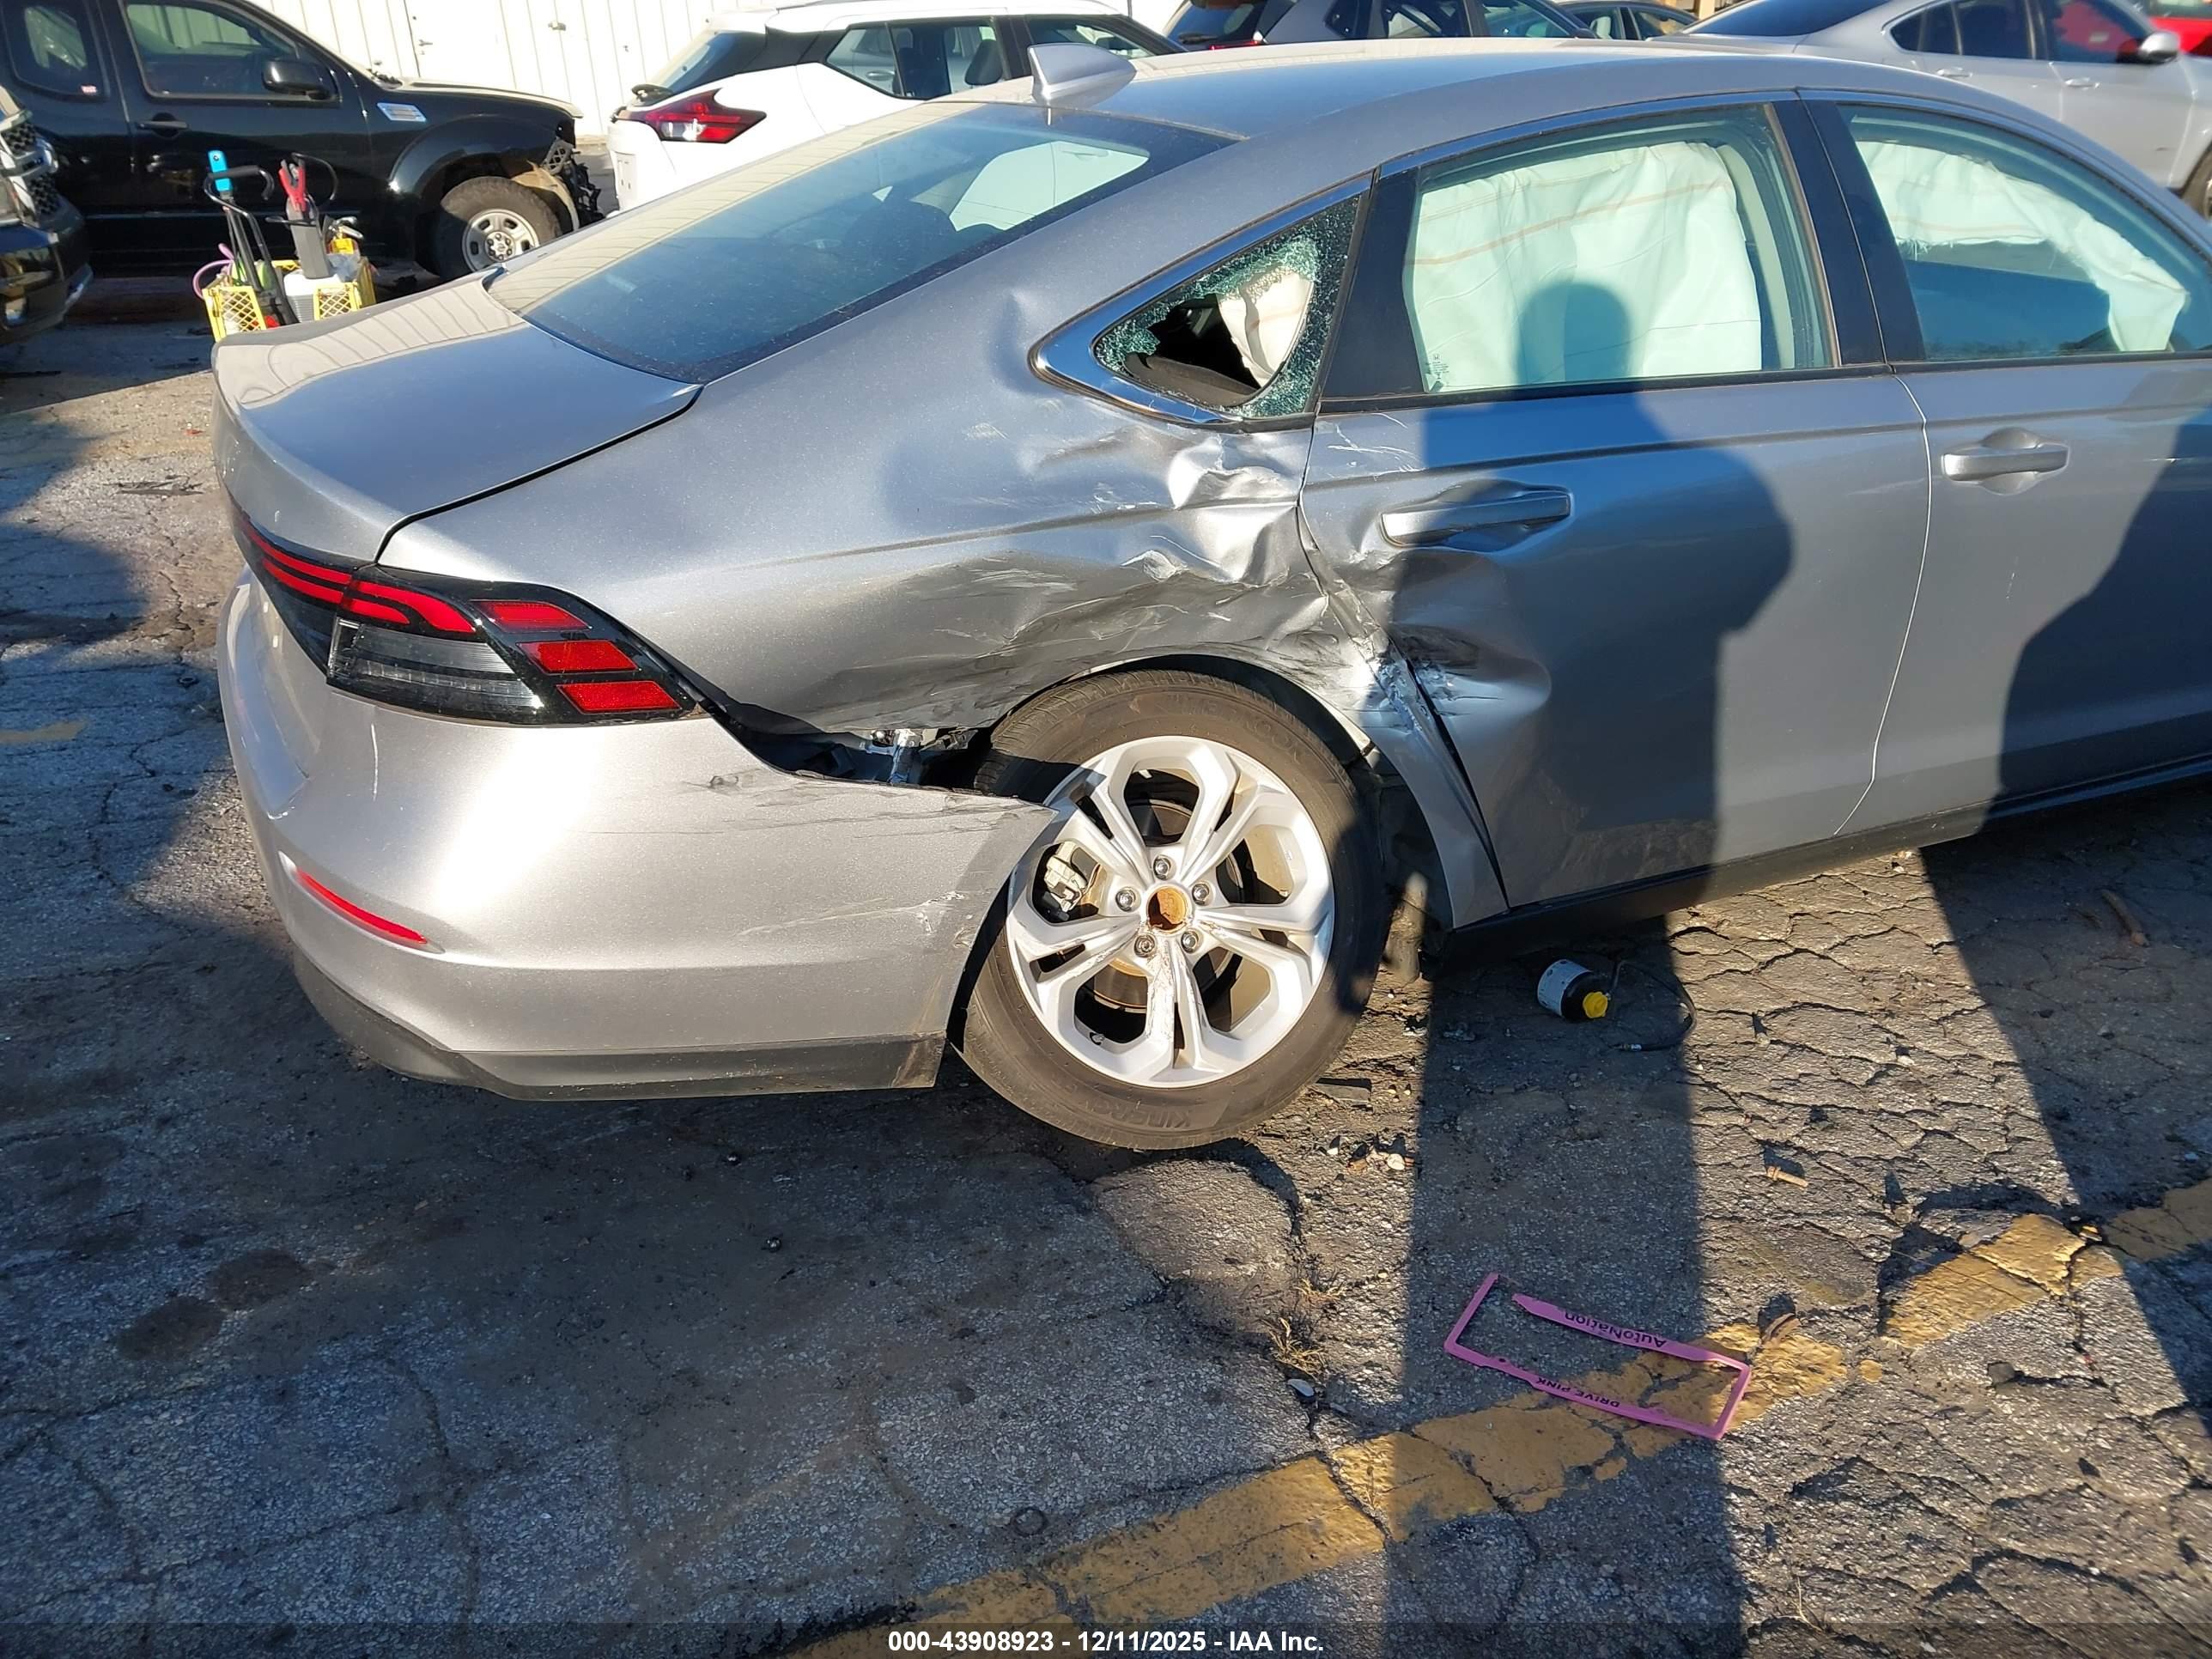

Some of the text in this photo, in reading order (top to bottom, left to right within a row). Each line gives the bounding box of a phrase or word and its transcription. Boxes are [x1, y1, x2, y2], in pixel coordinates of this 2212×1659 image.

[1565, 1310, 1667, 1348] AutoNation
[1535, 1376, 1620, 1408] DRIVE PINK
